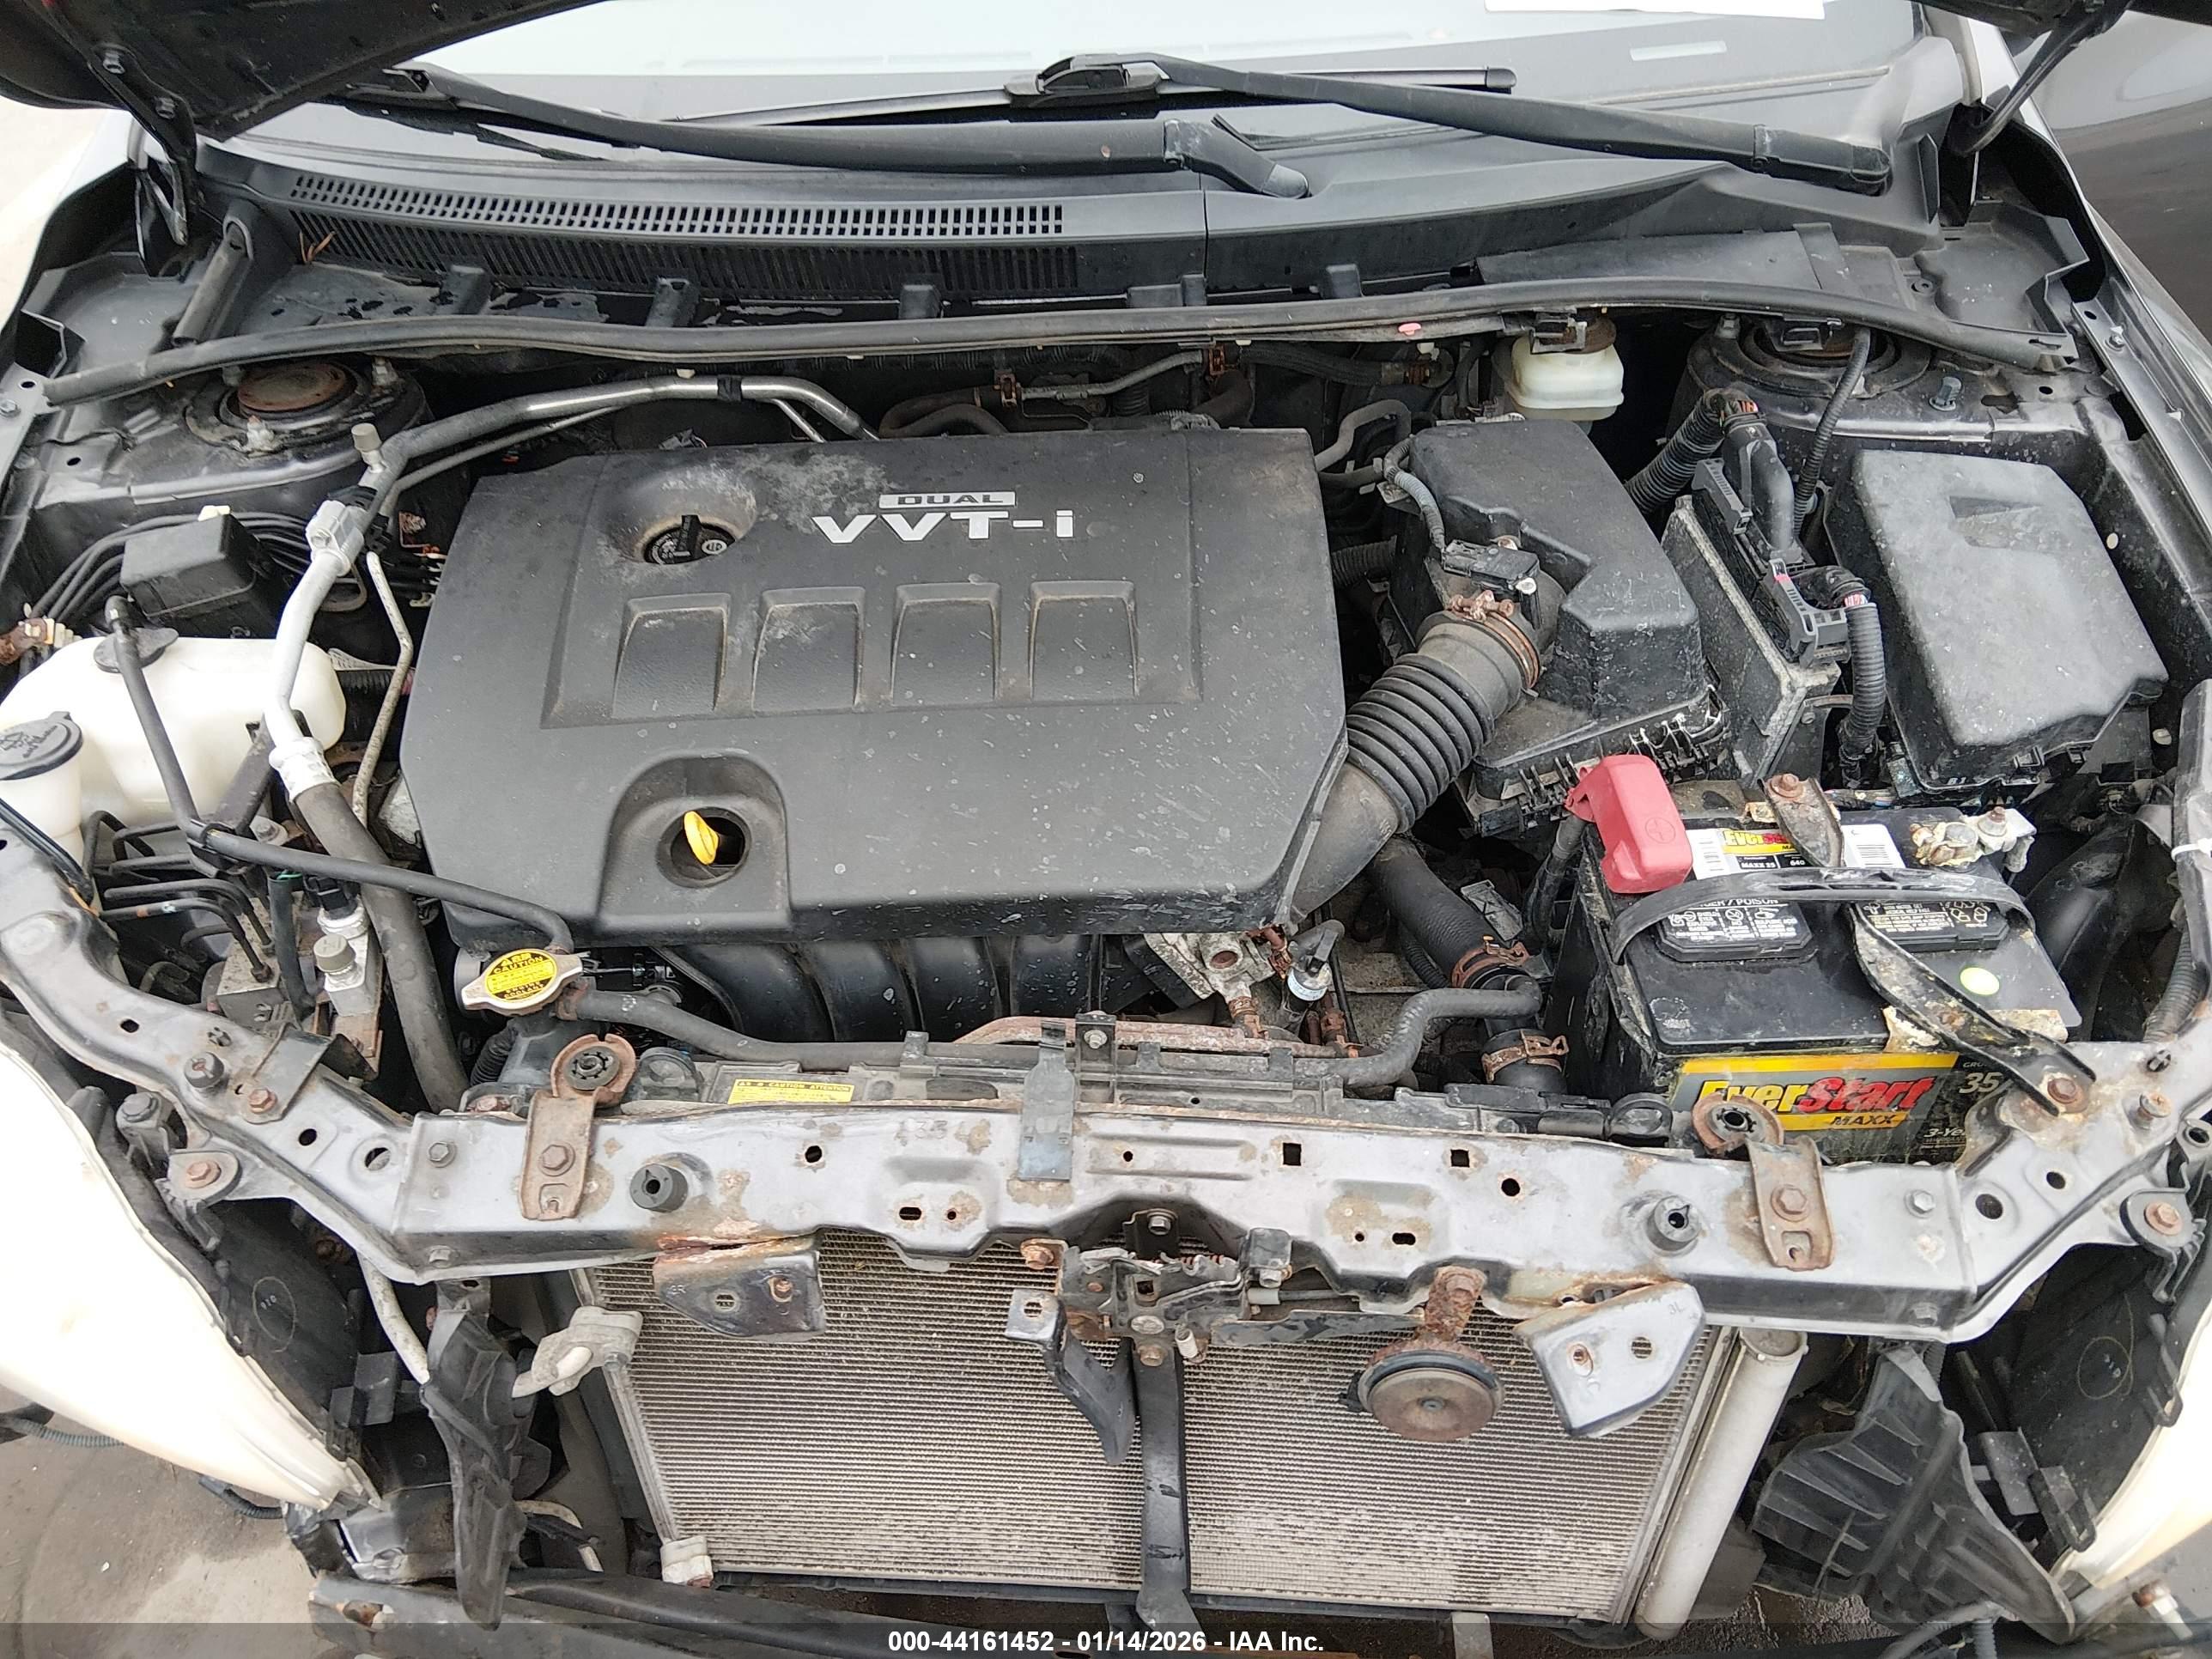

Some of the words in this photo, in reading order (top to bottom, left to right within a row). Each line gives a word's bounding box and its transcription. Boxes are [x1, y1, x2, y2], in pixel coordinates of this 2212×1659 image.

[897, 495, 1004, 505] DUAL
[493, 957, 544, 974] CAUTION
[1959, 1072, 2003, 1094] 35
[1830, 1115, 1899, 1127] MAXX
